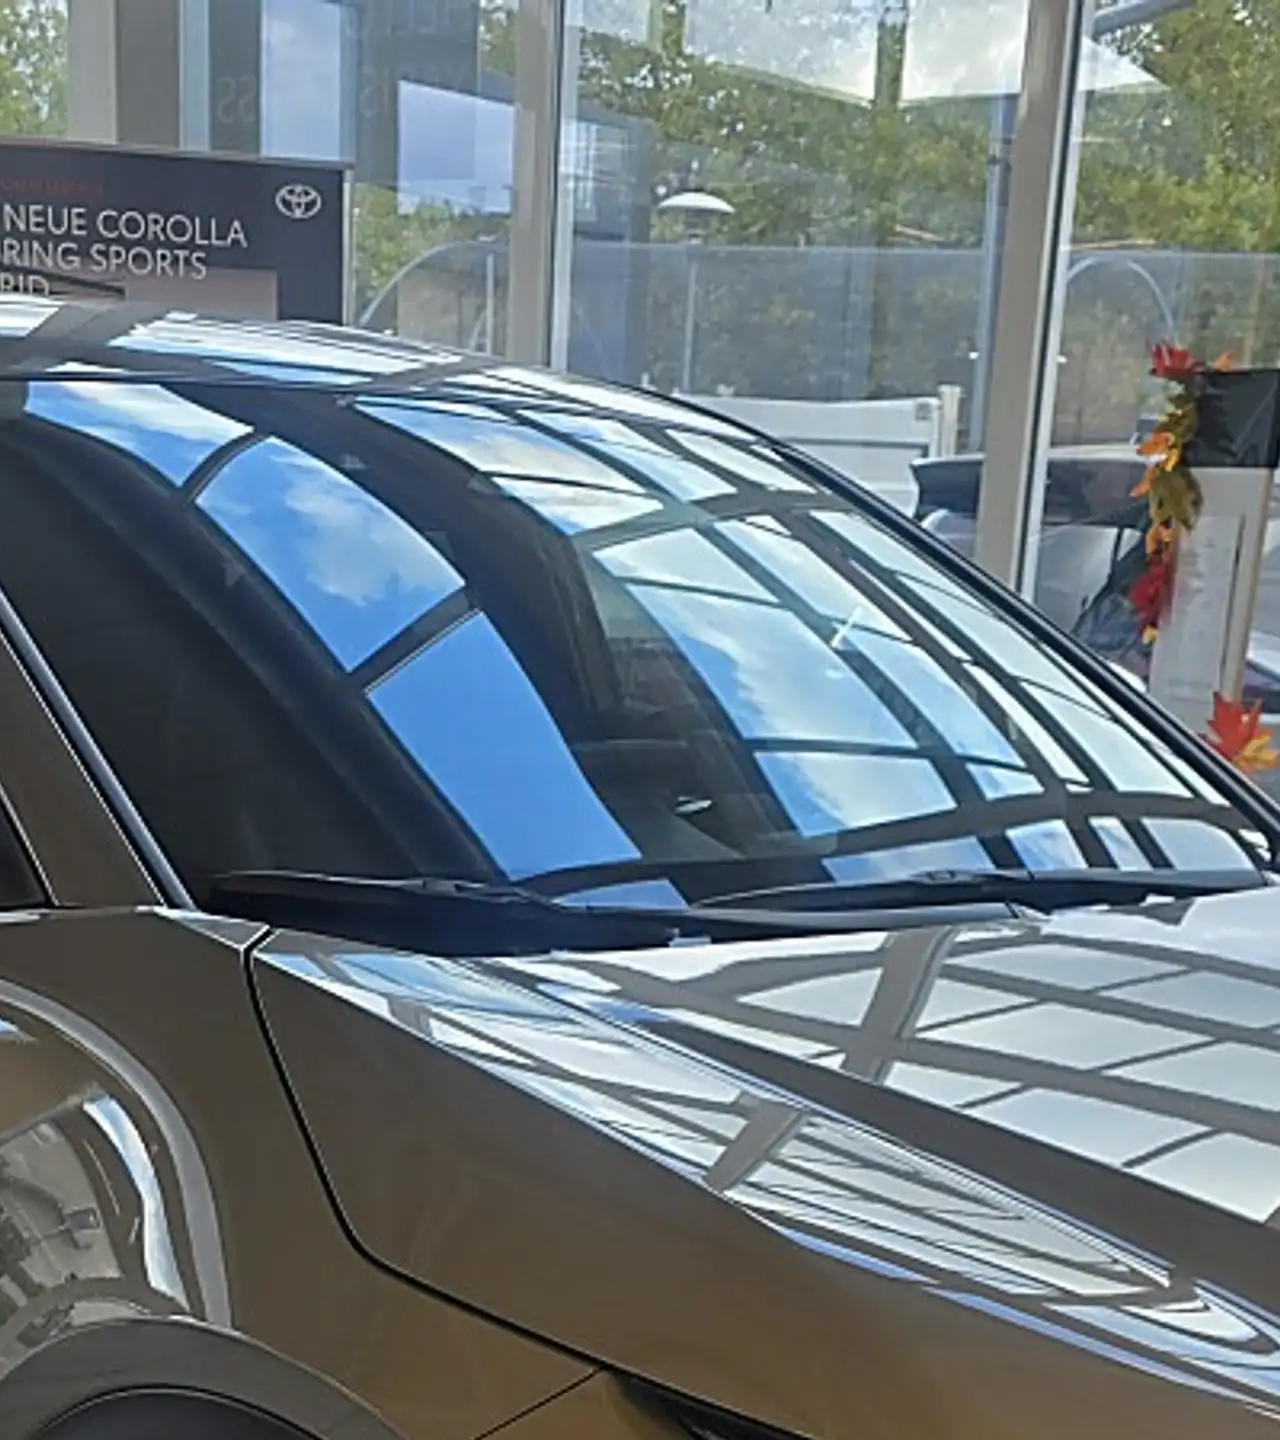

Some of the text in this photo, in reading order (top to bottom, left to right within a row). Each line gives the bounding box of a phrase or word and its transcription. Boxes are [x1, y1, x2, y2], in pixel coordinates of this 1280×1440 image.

[3, 204, 87, 236] NEUE
[96, 209, 248, 249] COROLLA
[90, 248, 207, 280] SPORTS
